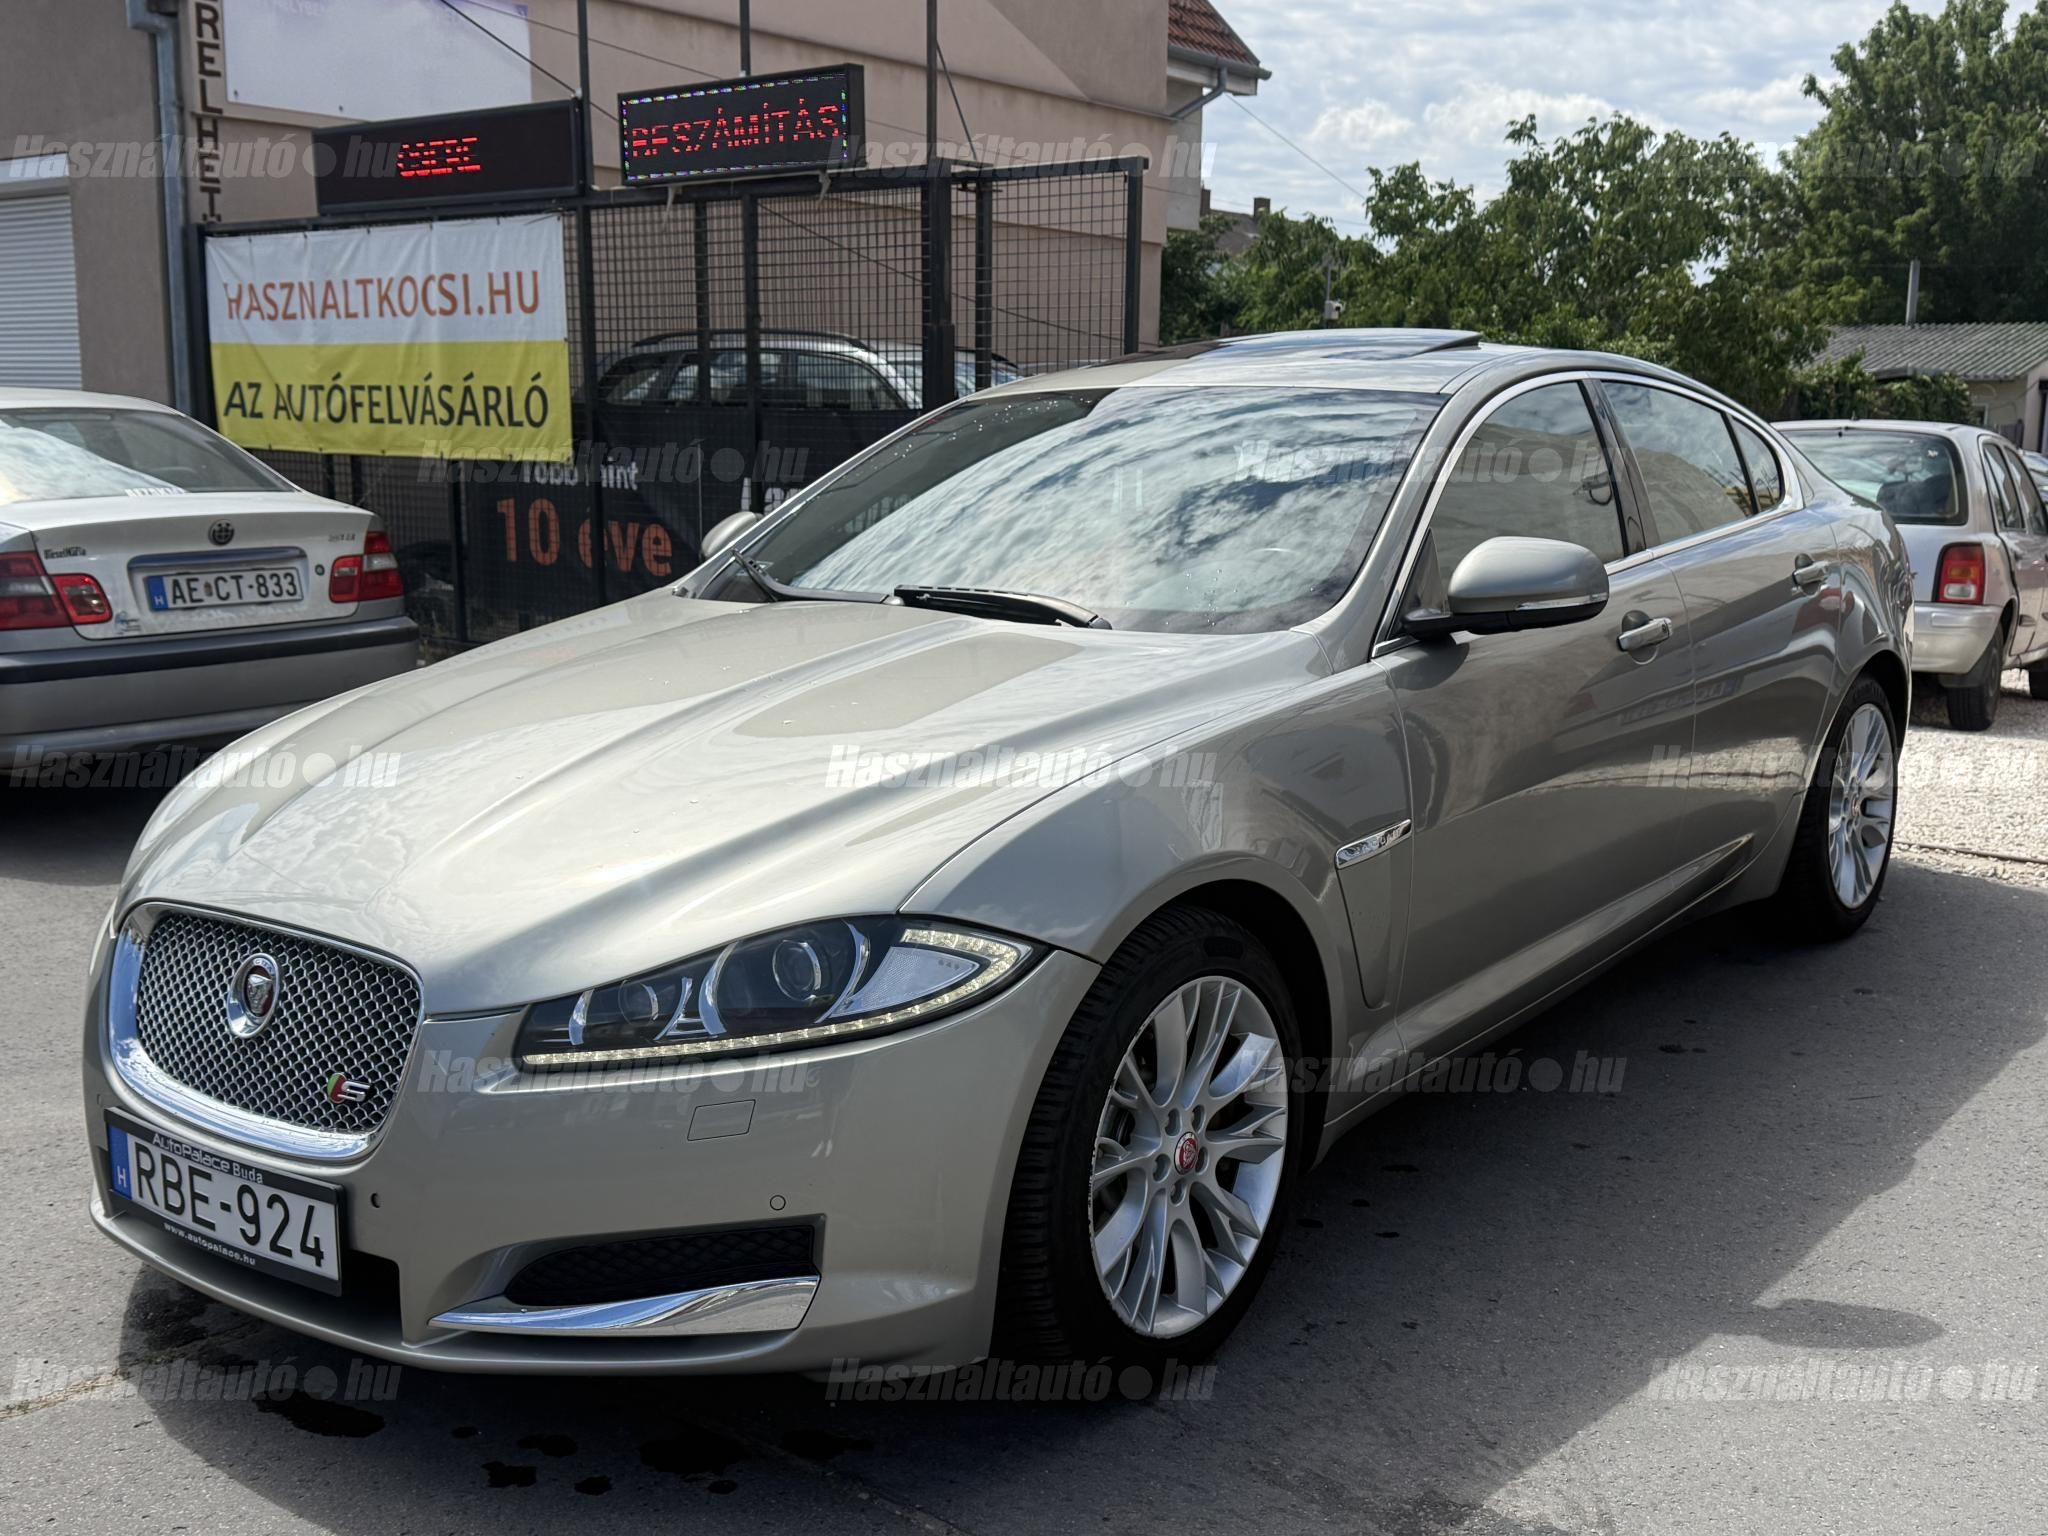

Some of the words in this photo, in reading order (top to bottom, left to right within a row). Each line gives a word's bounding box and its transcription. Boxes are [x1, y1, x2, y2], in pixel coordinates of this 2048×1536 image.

[223, 270, 540, 321] HASZNALTKOCSI.HU
[223, 381, 264, 419] AZ
[273, 371, 549, 429] AUTÓFELVÁSÁRLÓ
[497, 497, 560, 567] 10
[155, 596, 164, 605] H
[171, 577, 203, 605] AE
[214, 572, 297, 601] CT-833
[232, 1161, 264, 1185] Buda
[117, 1166, 128, 1188] H
[135, 1142, 325, 1268] RBE-924
[163, 1222, 256, 1266] www.autopalace.hu
